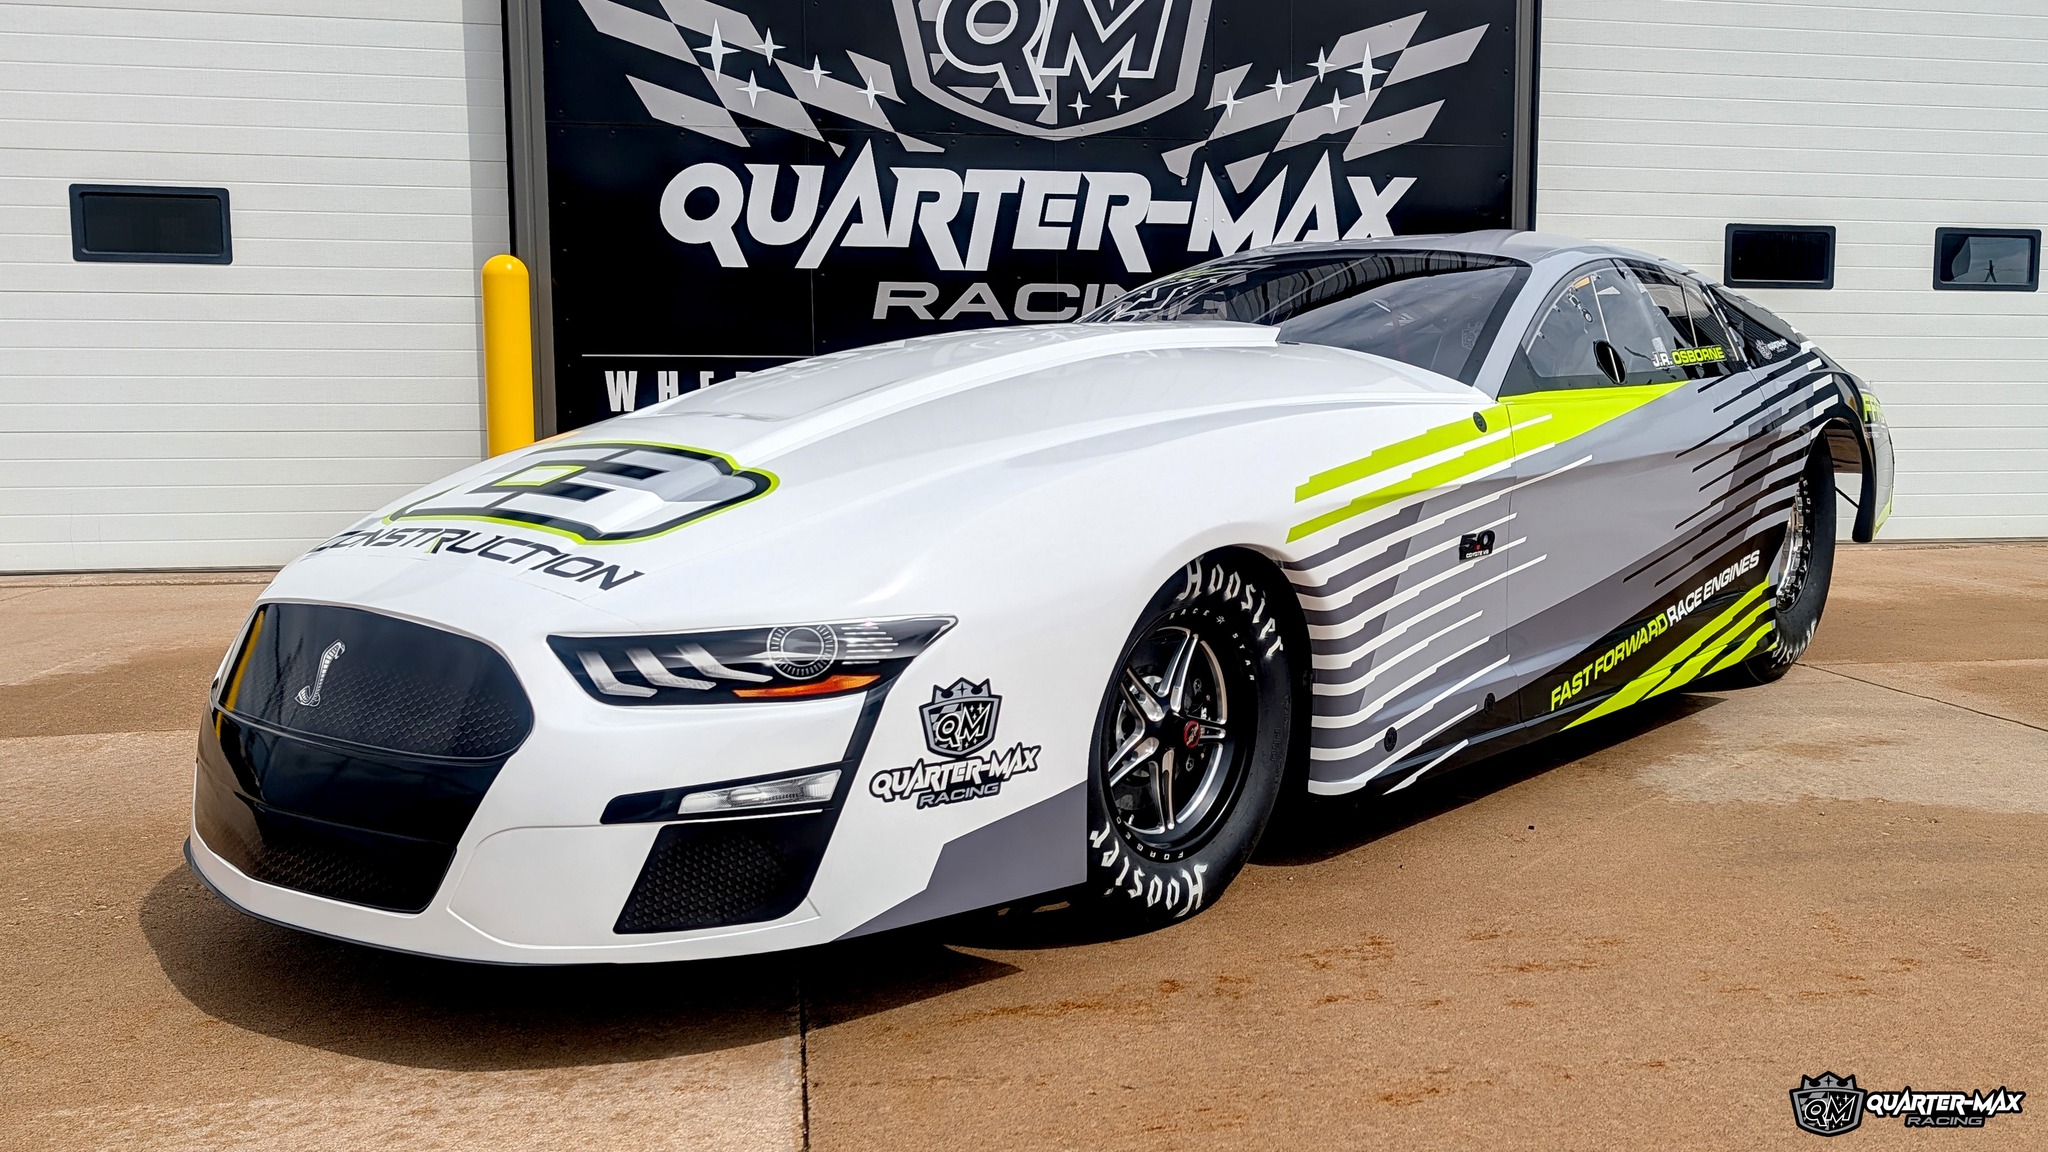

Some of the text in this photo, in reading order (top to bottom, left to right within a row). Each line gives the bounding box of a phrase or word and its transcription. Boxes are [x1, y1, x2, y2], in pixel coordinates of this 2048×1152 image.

[936, 0, 1173, 104] QM
[659, 139, 1418, 272] QUARTER-MAX
[1653, 346, 1725, 367] J.R. OSBORNE
[308, 527, 645, 591] CONSTRUCTION
[1551, 550, 1760, 711] FAST FORWARD RACE ENGINES
[937, 702, 992, 748] QM
[870, 744, 1040, 800] QUARTER-MAX
[919, 782, 1000, 807] RACING
[1116, 816, 1184, 861] FORGED
